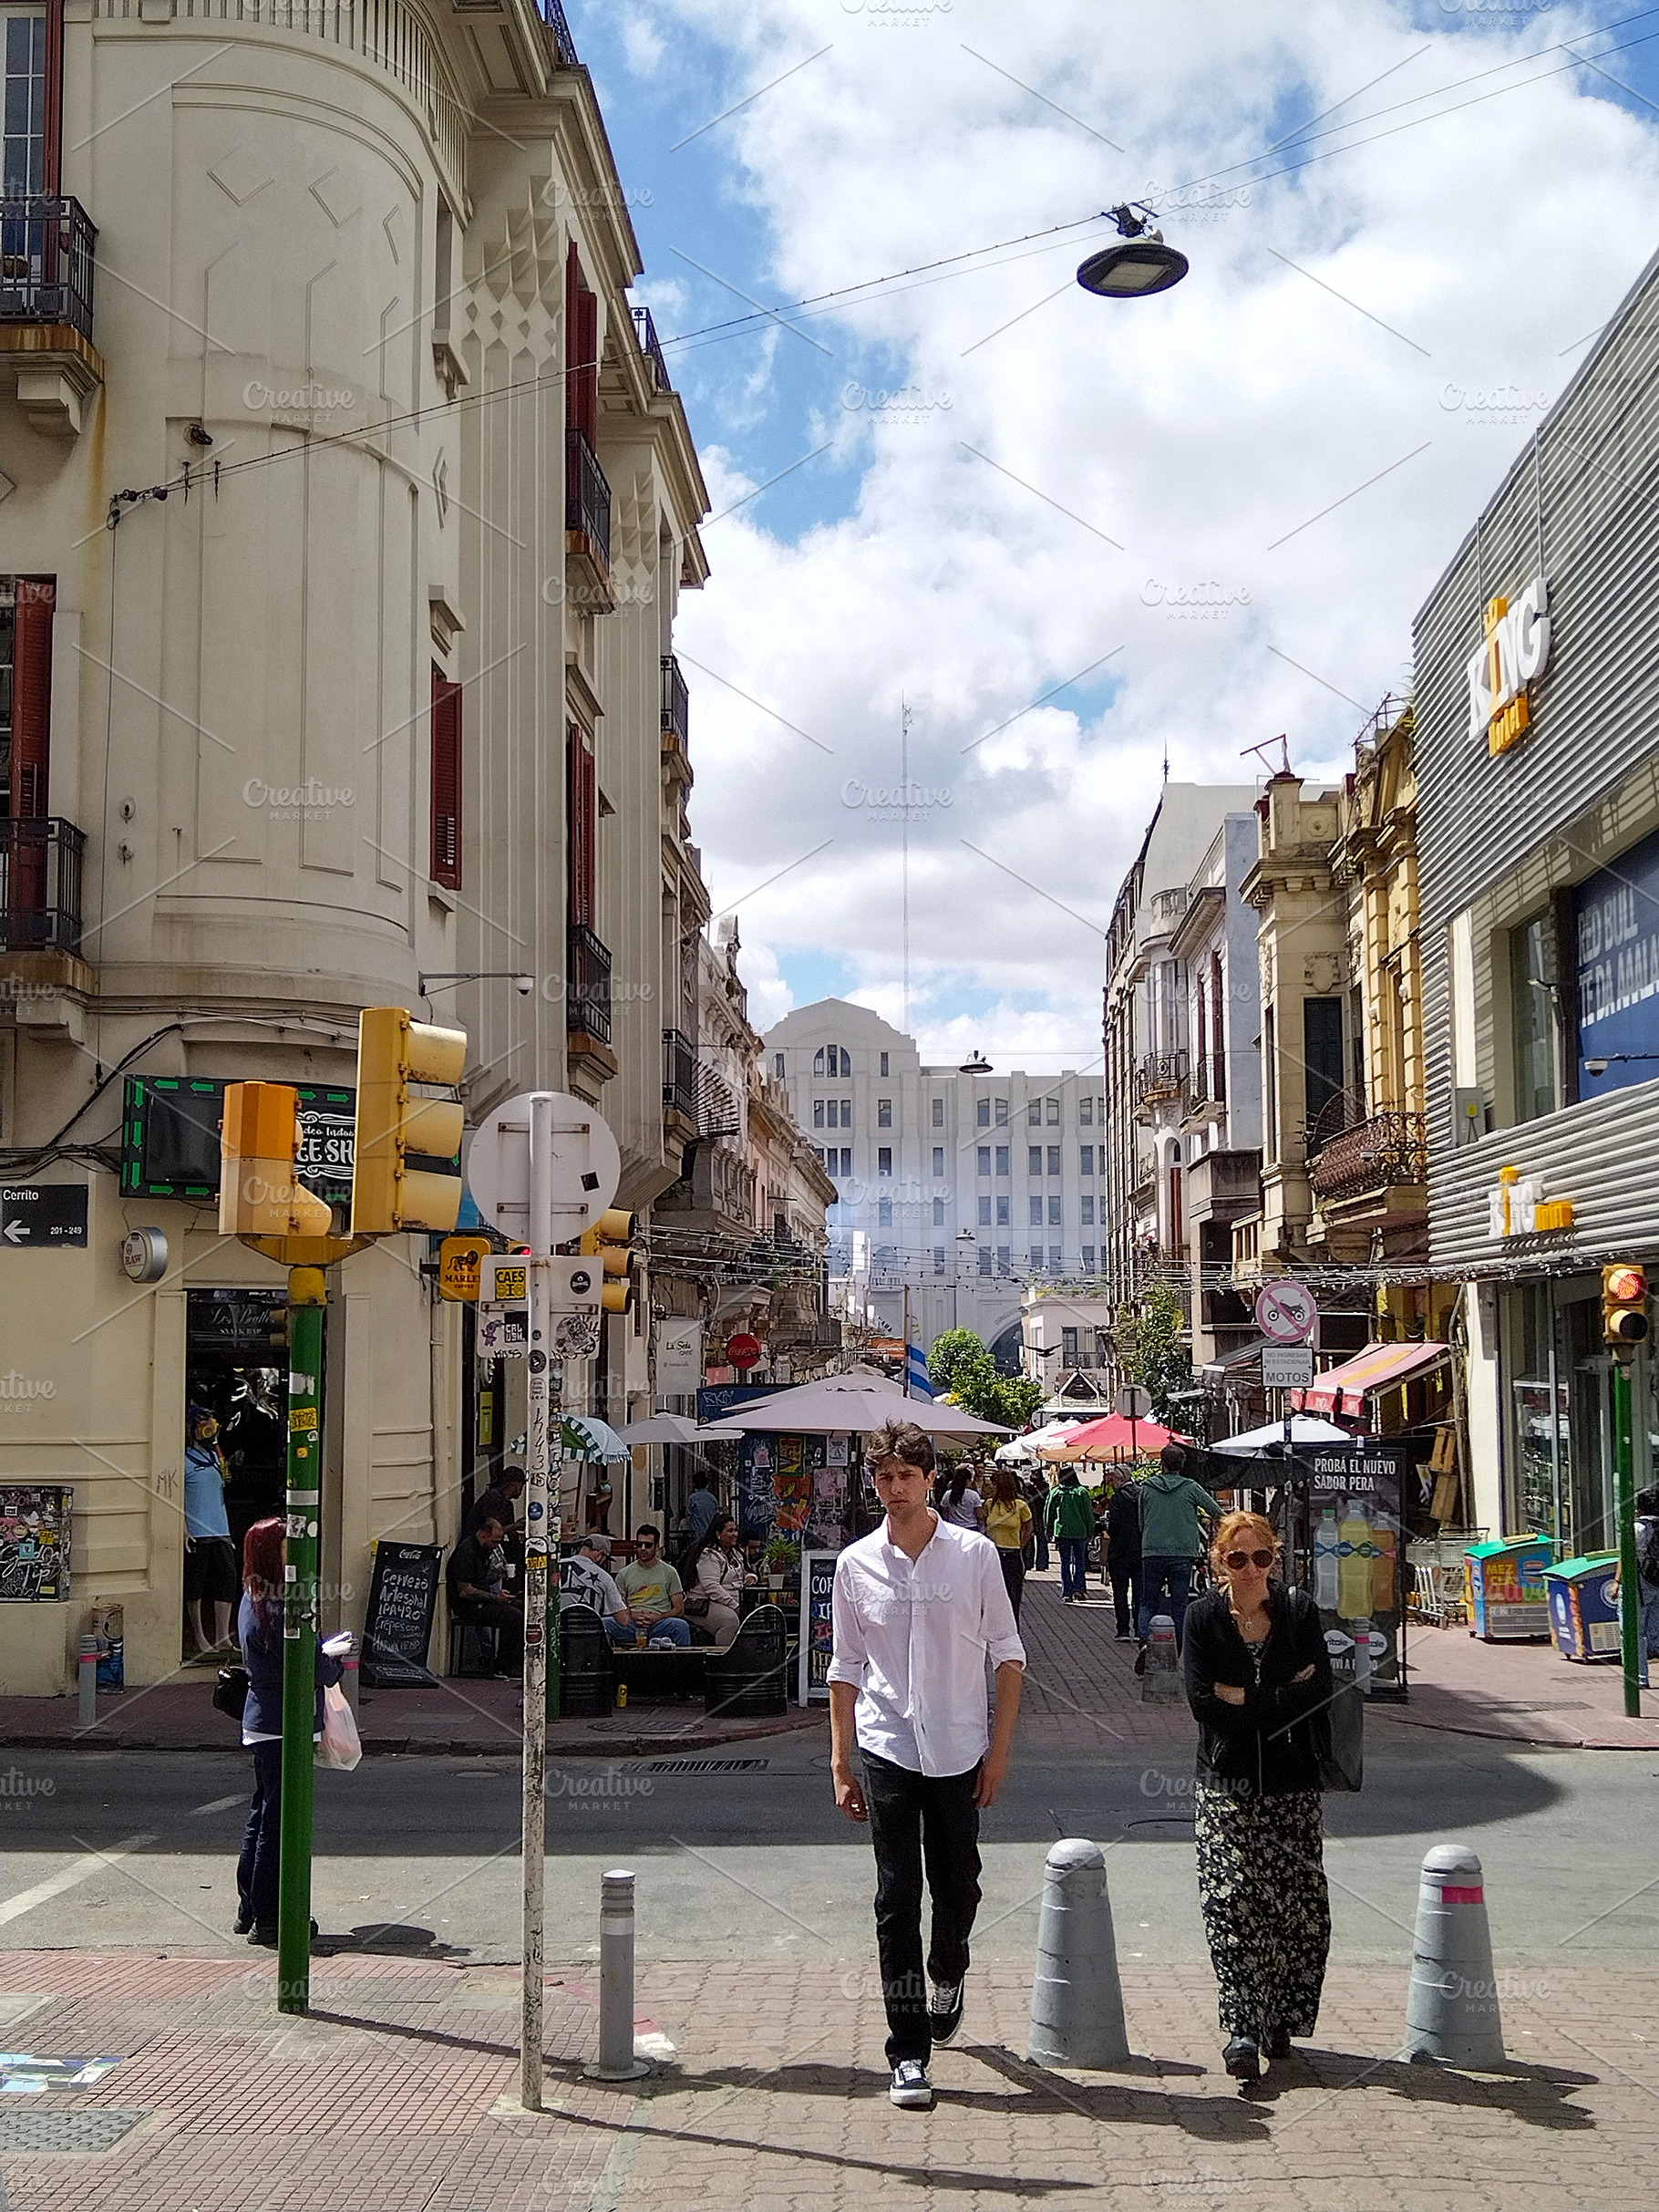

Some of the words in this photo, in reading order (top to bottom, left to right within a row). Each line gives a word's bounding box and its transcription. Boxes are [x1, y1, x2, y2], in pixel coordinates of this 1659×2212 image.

[1604, 884, 1638, 951] BULL
[1579, 969, 1595, 1028] TE
[1596, 959, 1616, 1021] DA
[3, 1189, 39, 1201] Cerrito
[125, 1254, 142, 1266] RAW
[497, 1270, 524, 1284] CAES
[1266, 1372, 1310, 1382] MOTOS
[1314, 1456, 1346, 1473] PROBÁ
[1349, 1459, 1362, 1473] EL
[1363, 1460, 1396, 1474] NUEVO
[1314, 1475, 1346, 1490] SABOR
[1349, 1476, 1375, 1491] PERA
